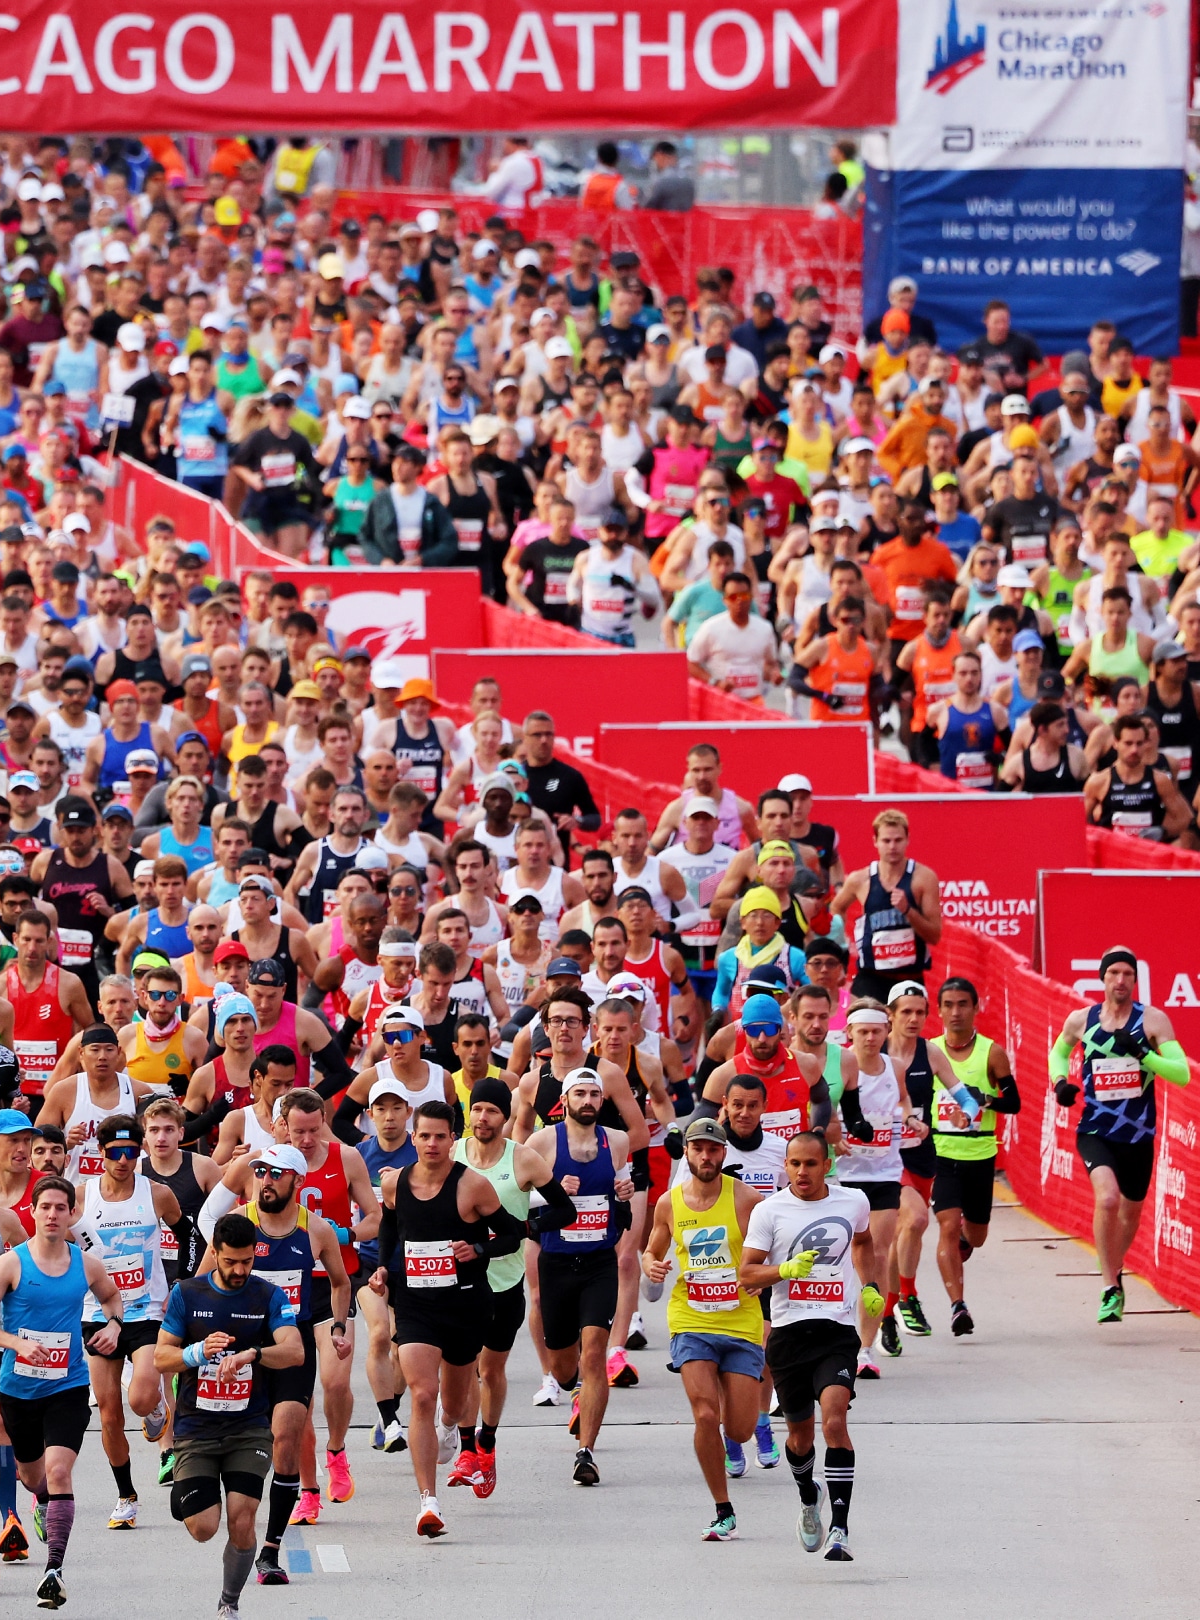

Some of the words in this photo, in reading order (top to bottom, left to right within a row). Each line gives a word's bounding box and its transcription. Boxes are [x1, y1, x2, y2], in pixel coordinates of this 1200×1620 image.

[271, 9, 839, 94] MARATHON
[998, 30, 1103, 58] Chicago
[998, 59, 1126, 80] Marathon
[966, 196, 1014, 217] What
[1018, 195, 1076, 217] would
[1079, 200, 1115, 222] you
[941, 220, 974, 240] like
[978, 220, 1010, 240] the
[1012, 223, 1072, 244] power
[1076, 220, 1098, 241] to
[1101, 218, 1137, 241] do?
[921, 257, 981, 275] BANK
[984, 257, 1013, 276] OF
[1015, 257, 1113, 276] AMERICA
[939, 881, 989, 897] TATA
[960, 919, 1020, 936] VICES
[24, 1057, 56, 1066] 25440
[1095, 1076, 1102, 1086] A
[1105, 1073, 1139, 1085] 22039
[754, 1173, 774, 1181] RICA
[99, 1219, 144, 1229] ARGENTINA
[407, 1262, 416, 1271] A
[419, 1259, 453, 1271] 5073
[689, 1286, 696, 1295] A
[699, 1284, 737, 1295] 10030
[790, 1283, 801, 1294] A
[806, 1283, 842, 1294] 4070
[198, 1383, 208, 1394] A
[214, 1381, 249, 1395] 1122
